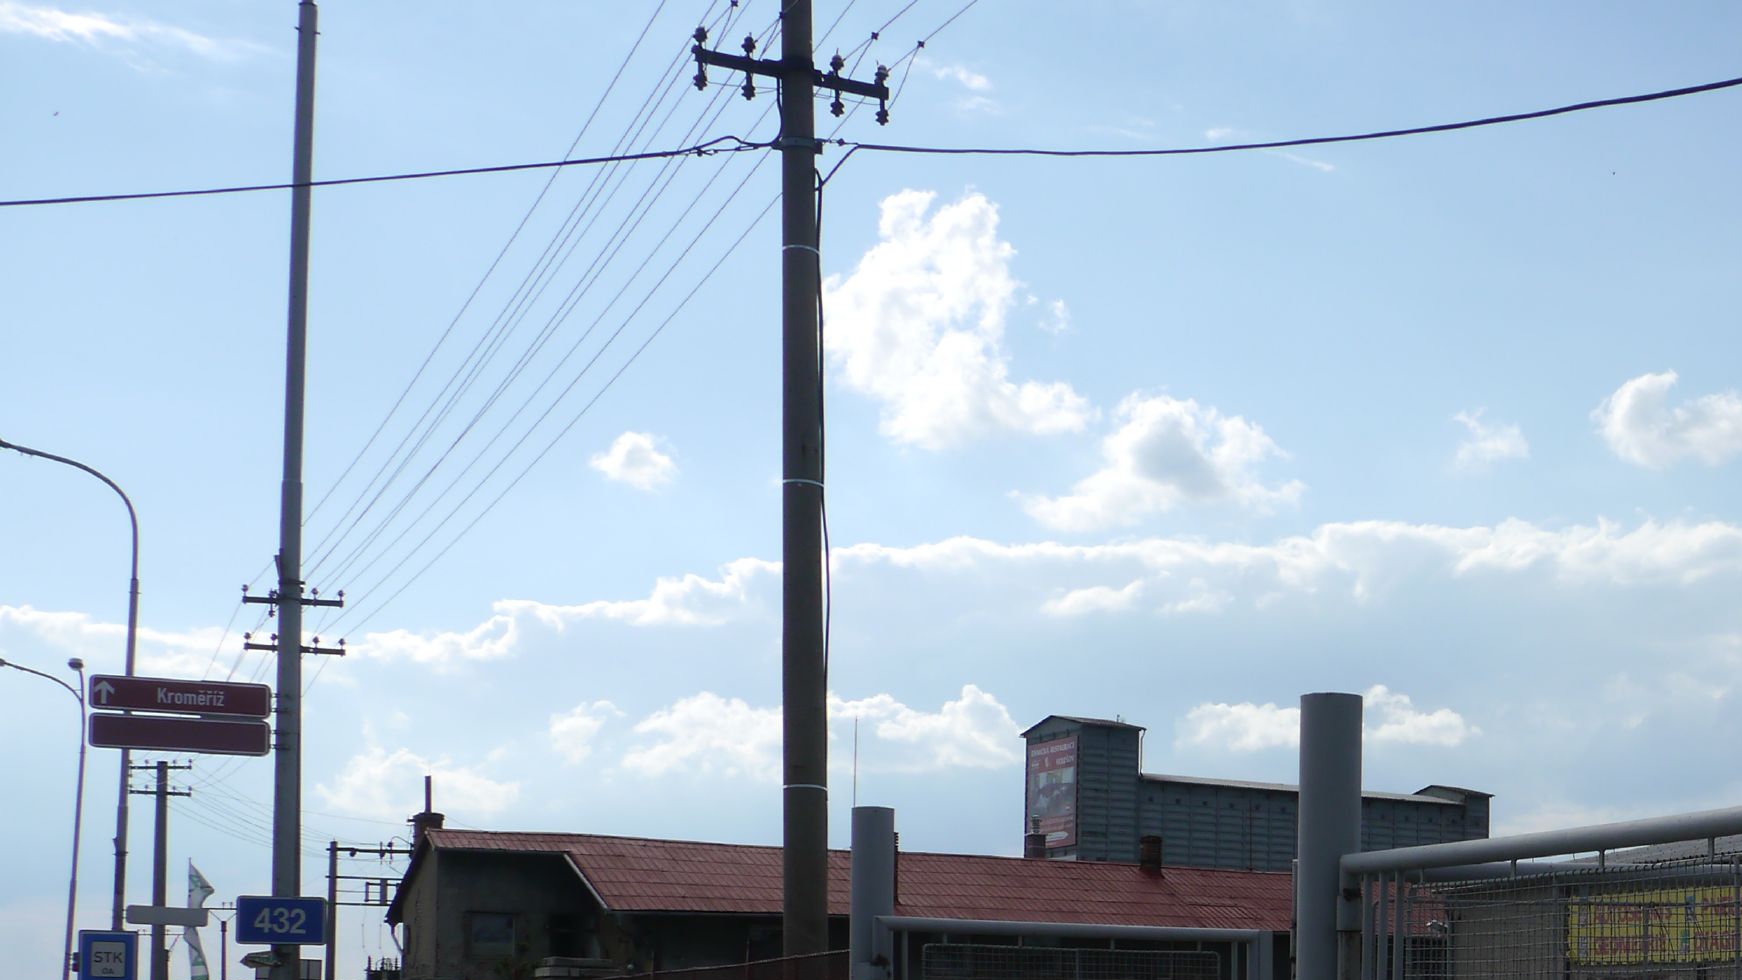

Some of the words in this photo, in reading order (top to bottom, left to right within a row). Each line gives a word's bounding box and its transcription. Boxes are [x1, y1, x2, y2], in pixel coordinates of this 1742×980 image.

[156, 687, 225, 707] Kroměříž
[254, 907, 306, 934] 432
[93, 951, 123, 963] STK
